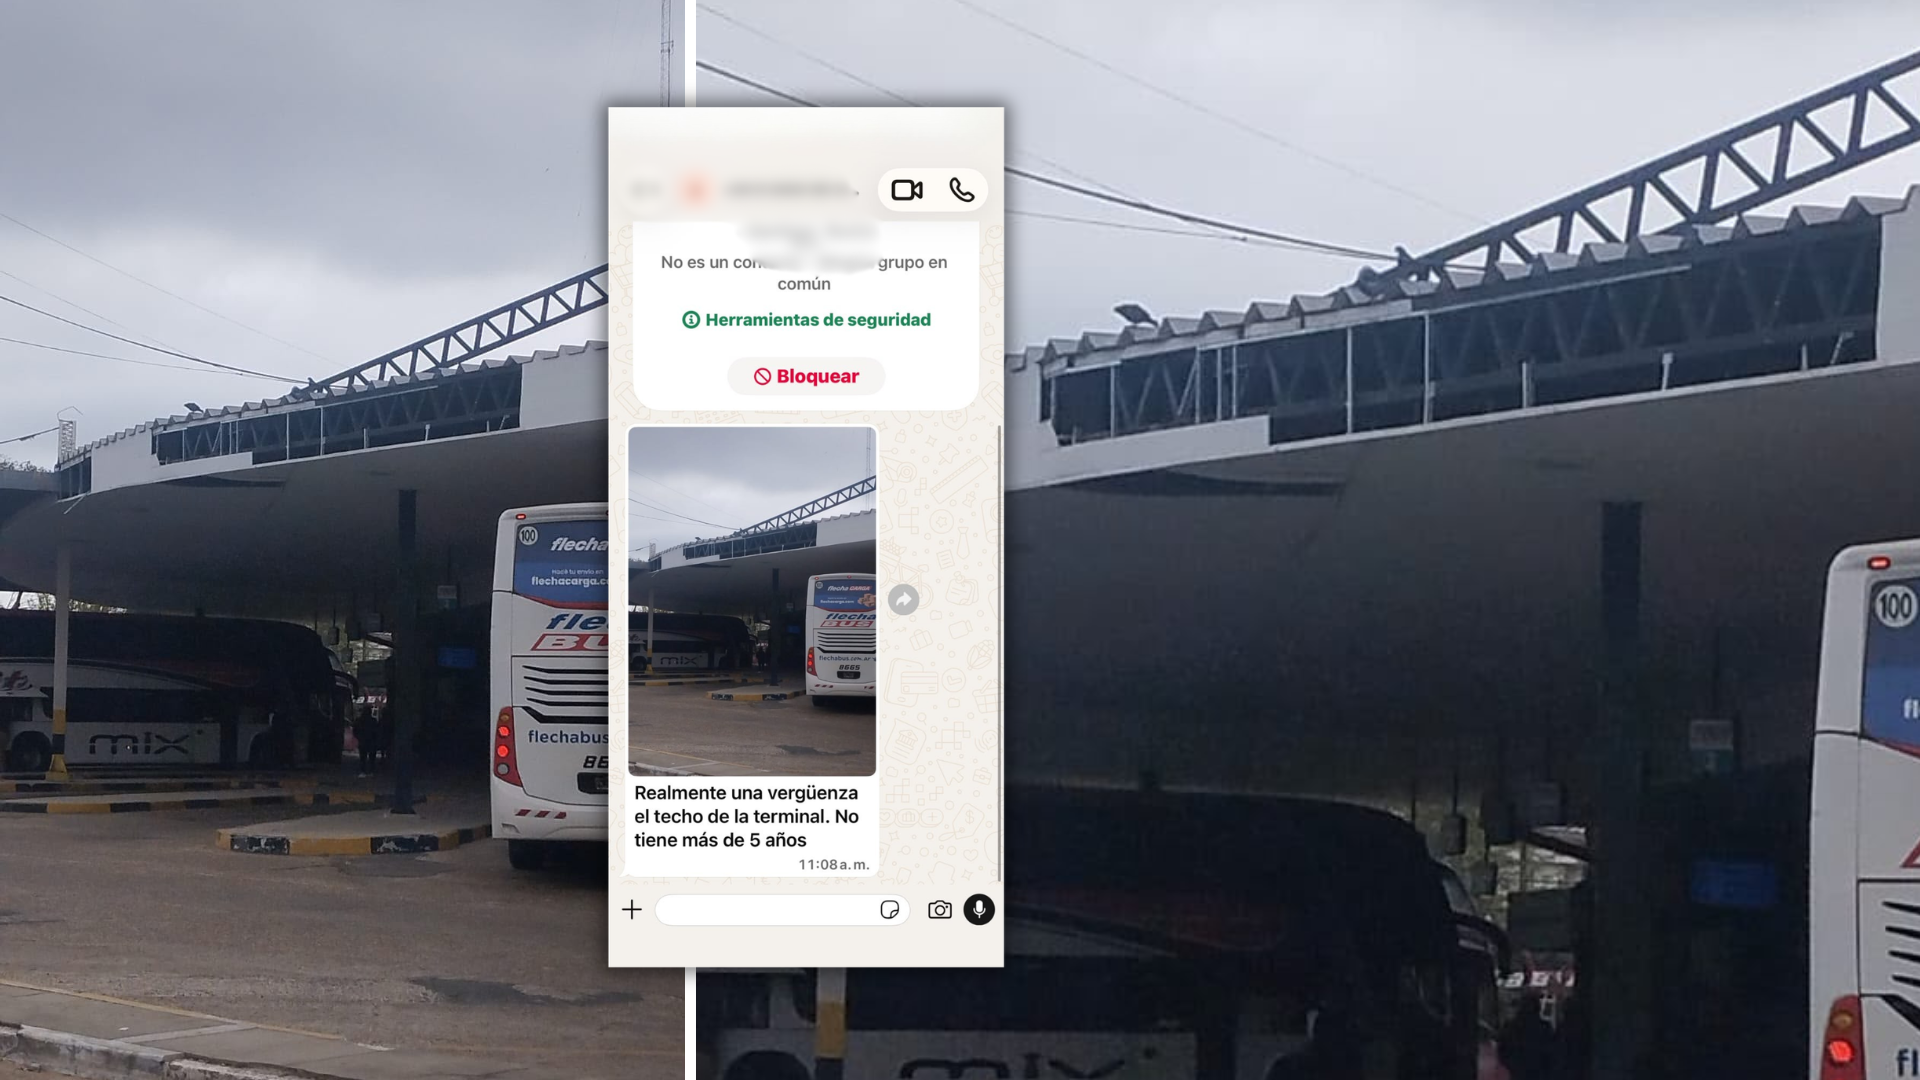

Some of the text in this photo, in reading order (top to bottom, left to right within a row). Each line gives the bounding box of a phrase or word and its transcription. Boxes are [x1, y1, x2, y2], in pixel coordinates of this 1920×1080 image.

[521, 529, 536, 542] 100
[550, 537, 609, 551] flecha
[1880, 592, 1912, 620] 100
[546, 613, 608, 630] fle
[89, 732, 190, 755] mix
[528, 730, 608, 743] flechabus
